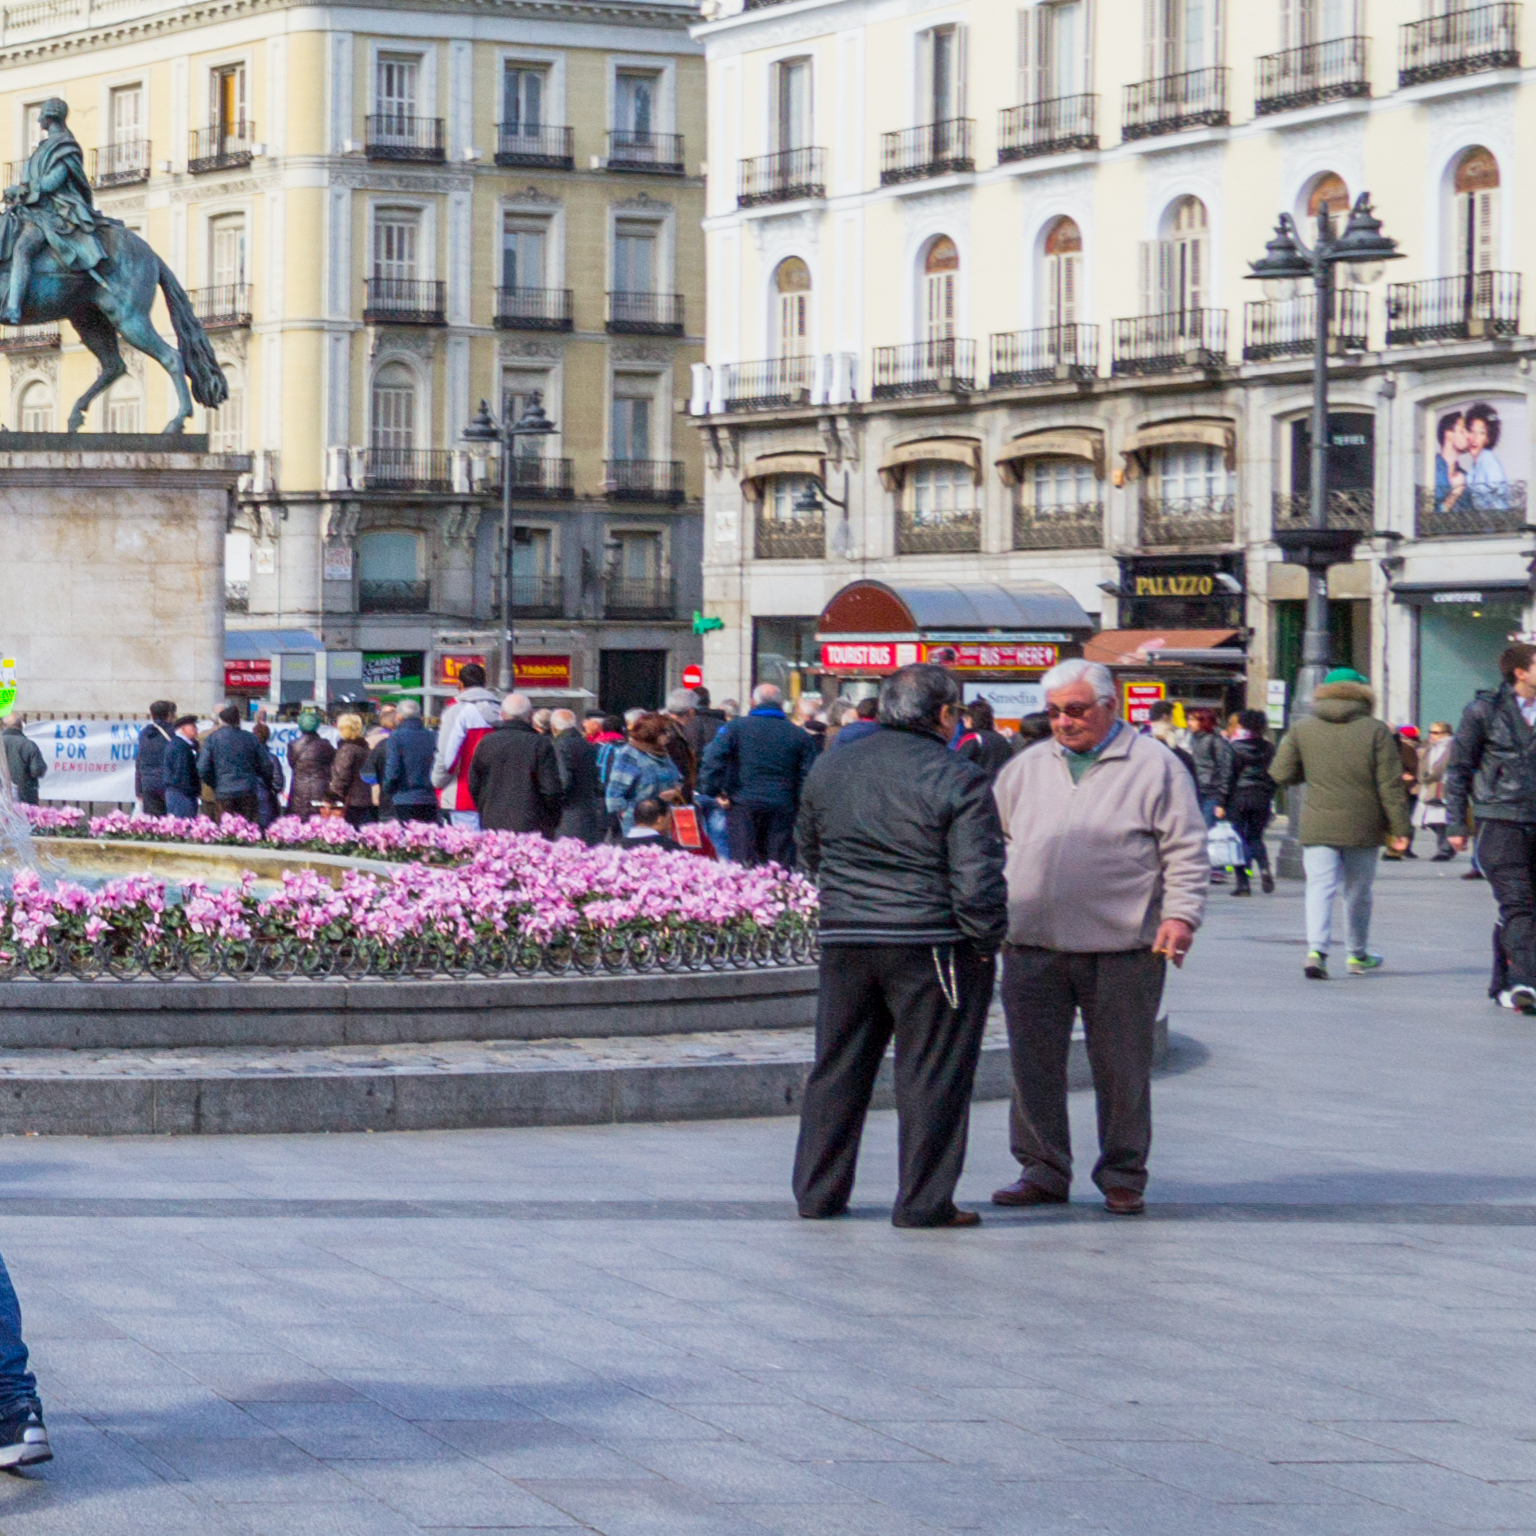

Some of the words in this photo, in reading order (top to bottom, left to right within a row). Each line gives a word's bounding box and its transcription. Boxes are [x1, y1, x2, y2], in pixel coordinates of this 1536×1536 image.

[1135, 575, 1213, 596] PALAZZO
[827, 645, 868, 664] TOURIST
[869, 646, 891, 665] BUS
[980, 645, 1000, 666] BUS
[1016, 645, 1046, 666] HERE
[243, 674, 270, 682] TOURIS
[521, 664, 568, 675] TABACOS
[55, 724, 87, 740] LOS
[110, 724, 142, 741] MAY
[55, 743, 87, 760] POR
[54, 762, 118, 773] PENSIONES
